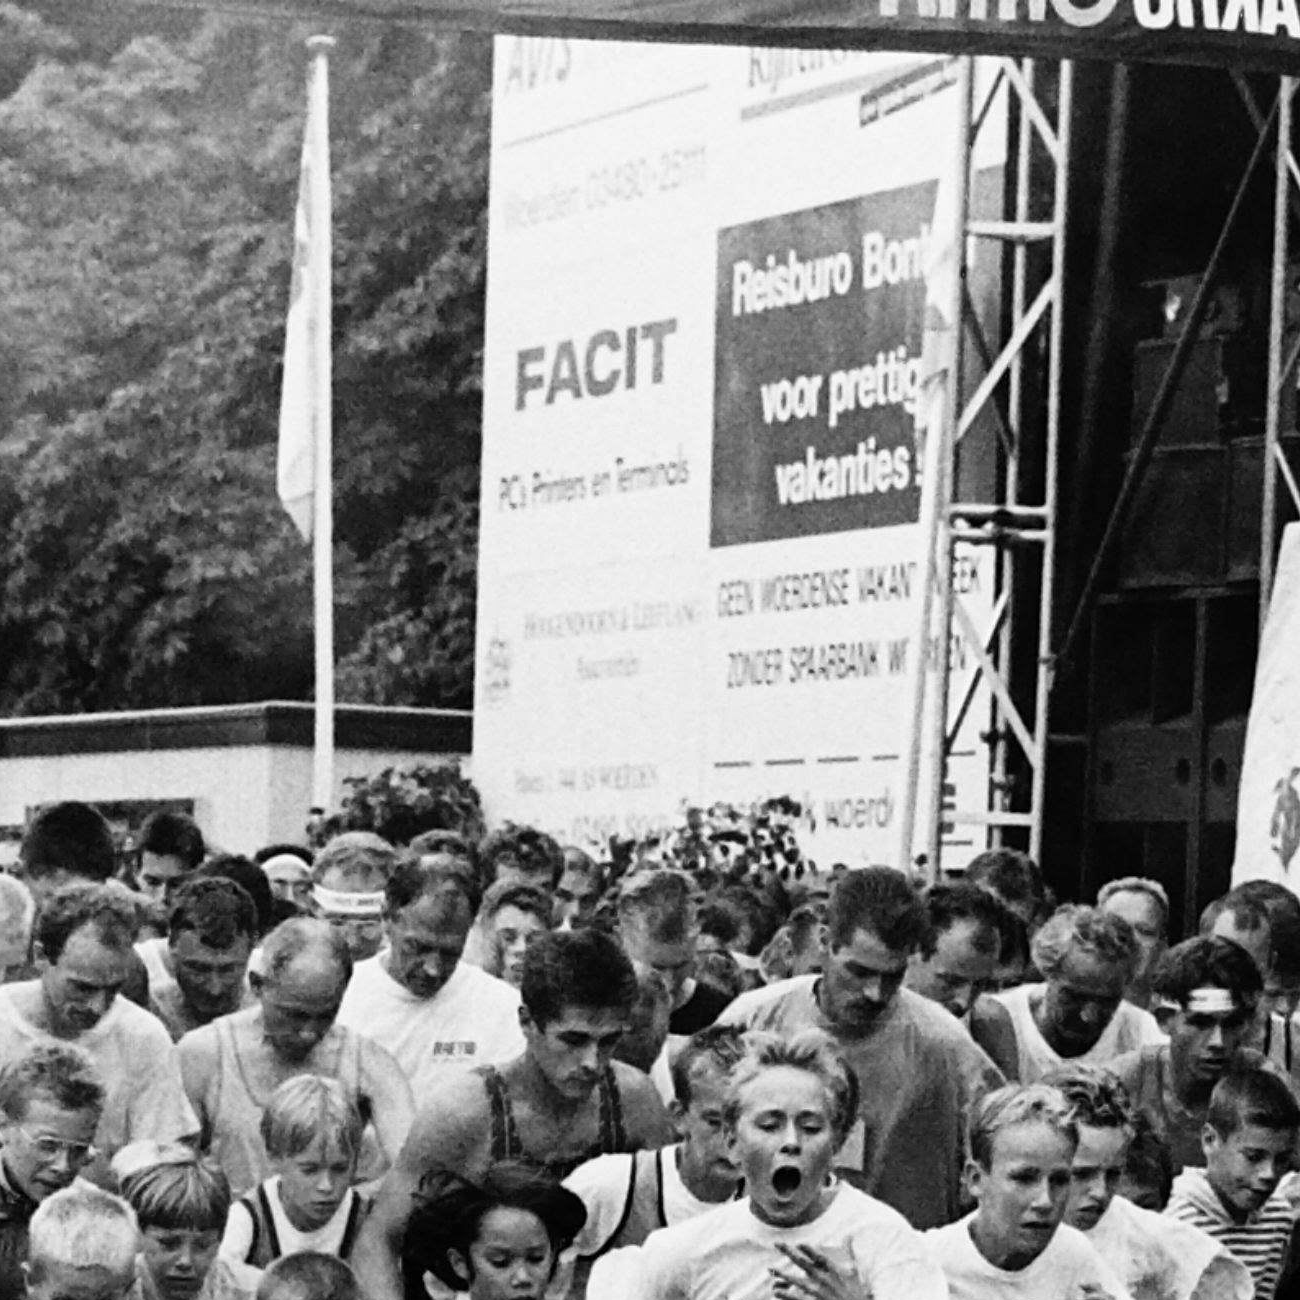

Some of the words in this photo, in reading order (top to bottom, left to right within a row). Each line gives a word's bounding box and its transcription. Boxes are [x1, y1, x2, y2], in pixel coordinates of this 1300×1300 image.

[731, 248, 852, 317] Reisburo
[860, 224, 928, 290] Bon
[513, 317, 676, 412] FACIT
[760, 375, 823, 424] voor
